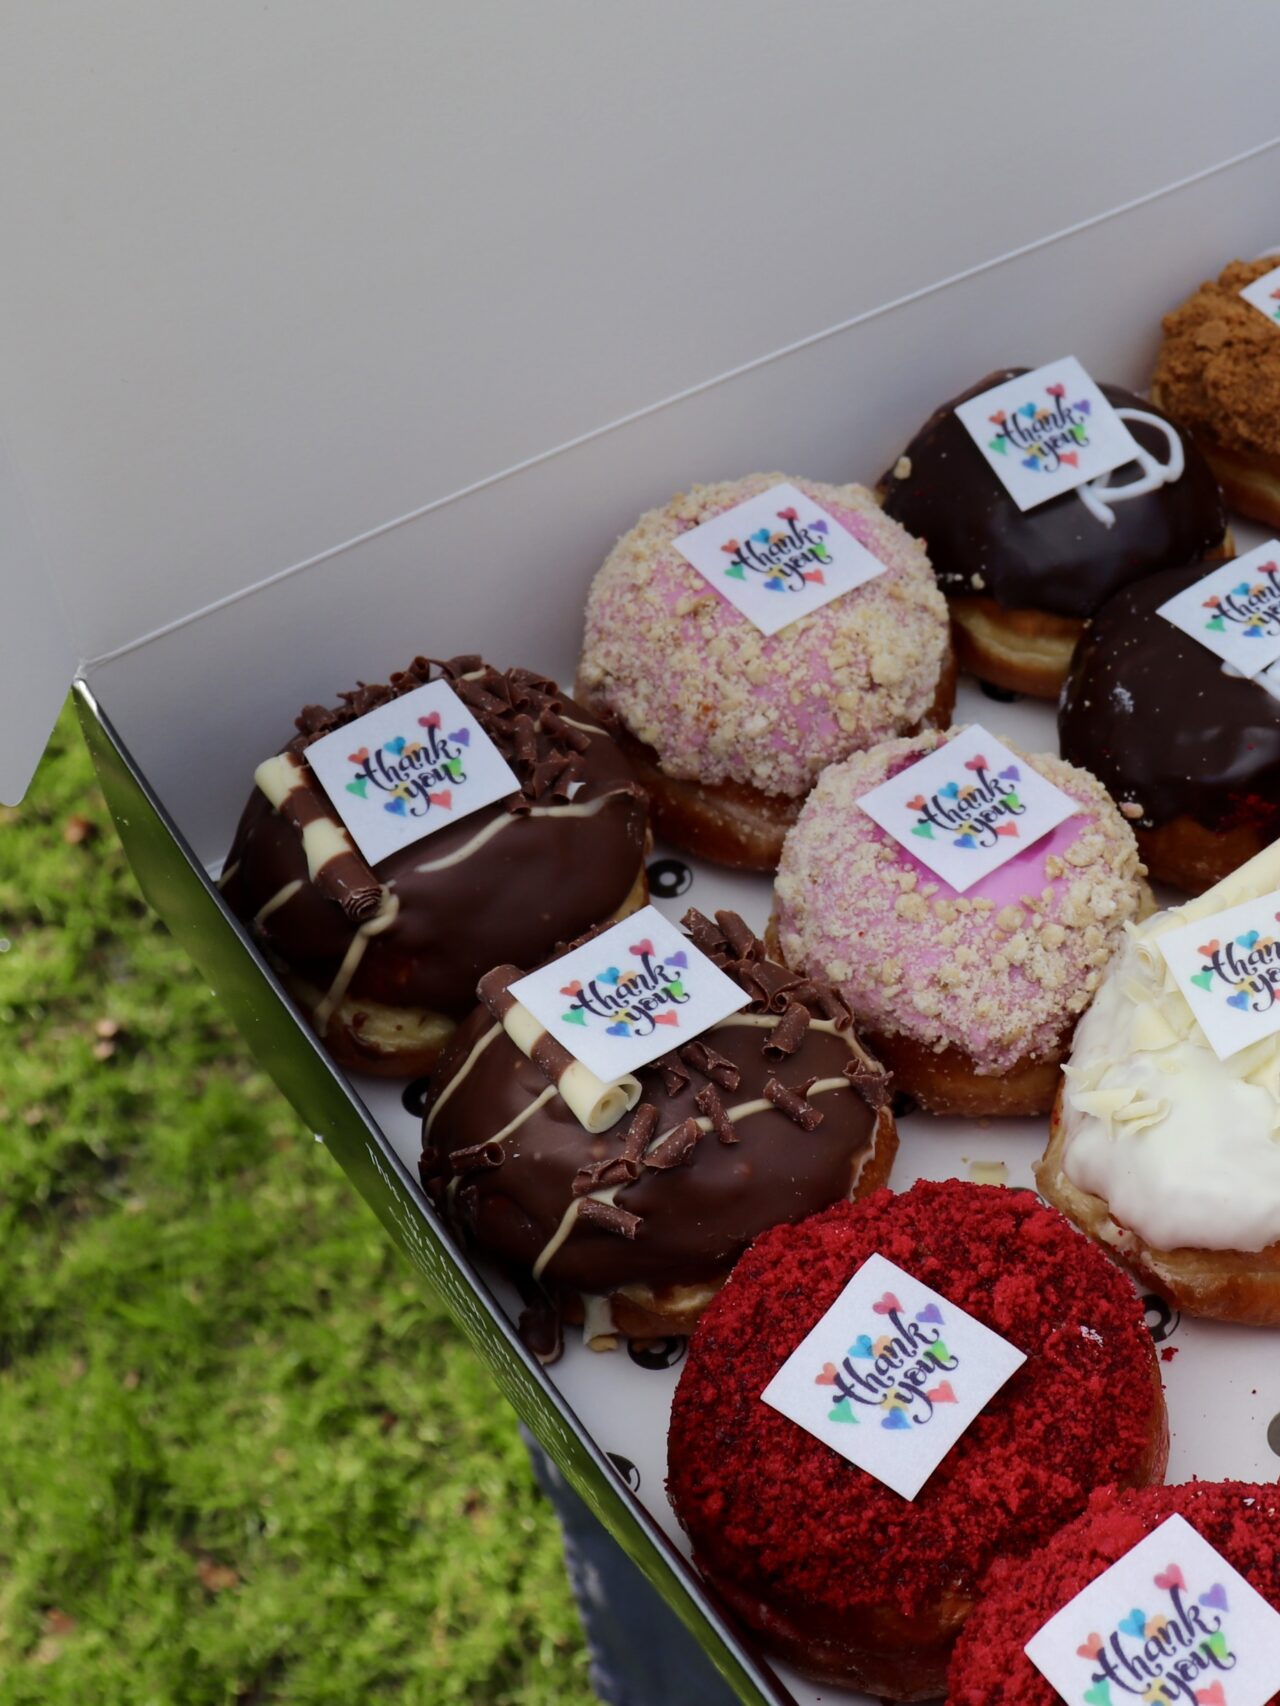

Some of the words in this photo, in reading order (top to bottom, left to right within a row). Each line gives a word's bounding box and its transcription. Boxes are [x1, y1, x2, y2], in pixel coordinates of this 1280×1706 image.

[995, 394, 1084, 450] thank
[1039, 429, 1090, 473] you
[731, 518, 823, 573] thank
[783, 547, 833, 592] you
[354, 724, 461, 792] thank
[405, 763, 467, 817] you
[917, 767, 1015, 831] thank
[970, 799, 1026, 848] you
[570, 952, 681, 1018] thank
[624, 985, 690, 1037] you
[832, 1307, 940, 1408] thank
[896, 1350, 959, 1425] you
[1091, 1584, 1221, 1694] thank
[1159, 1640, 1237, 1706] you
